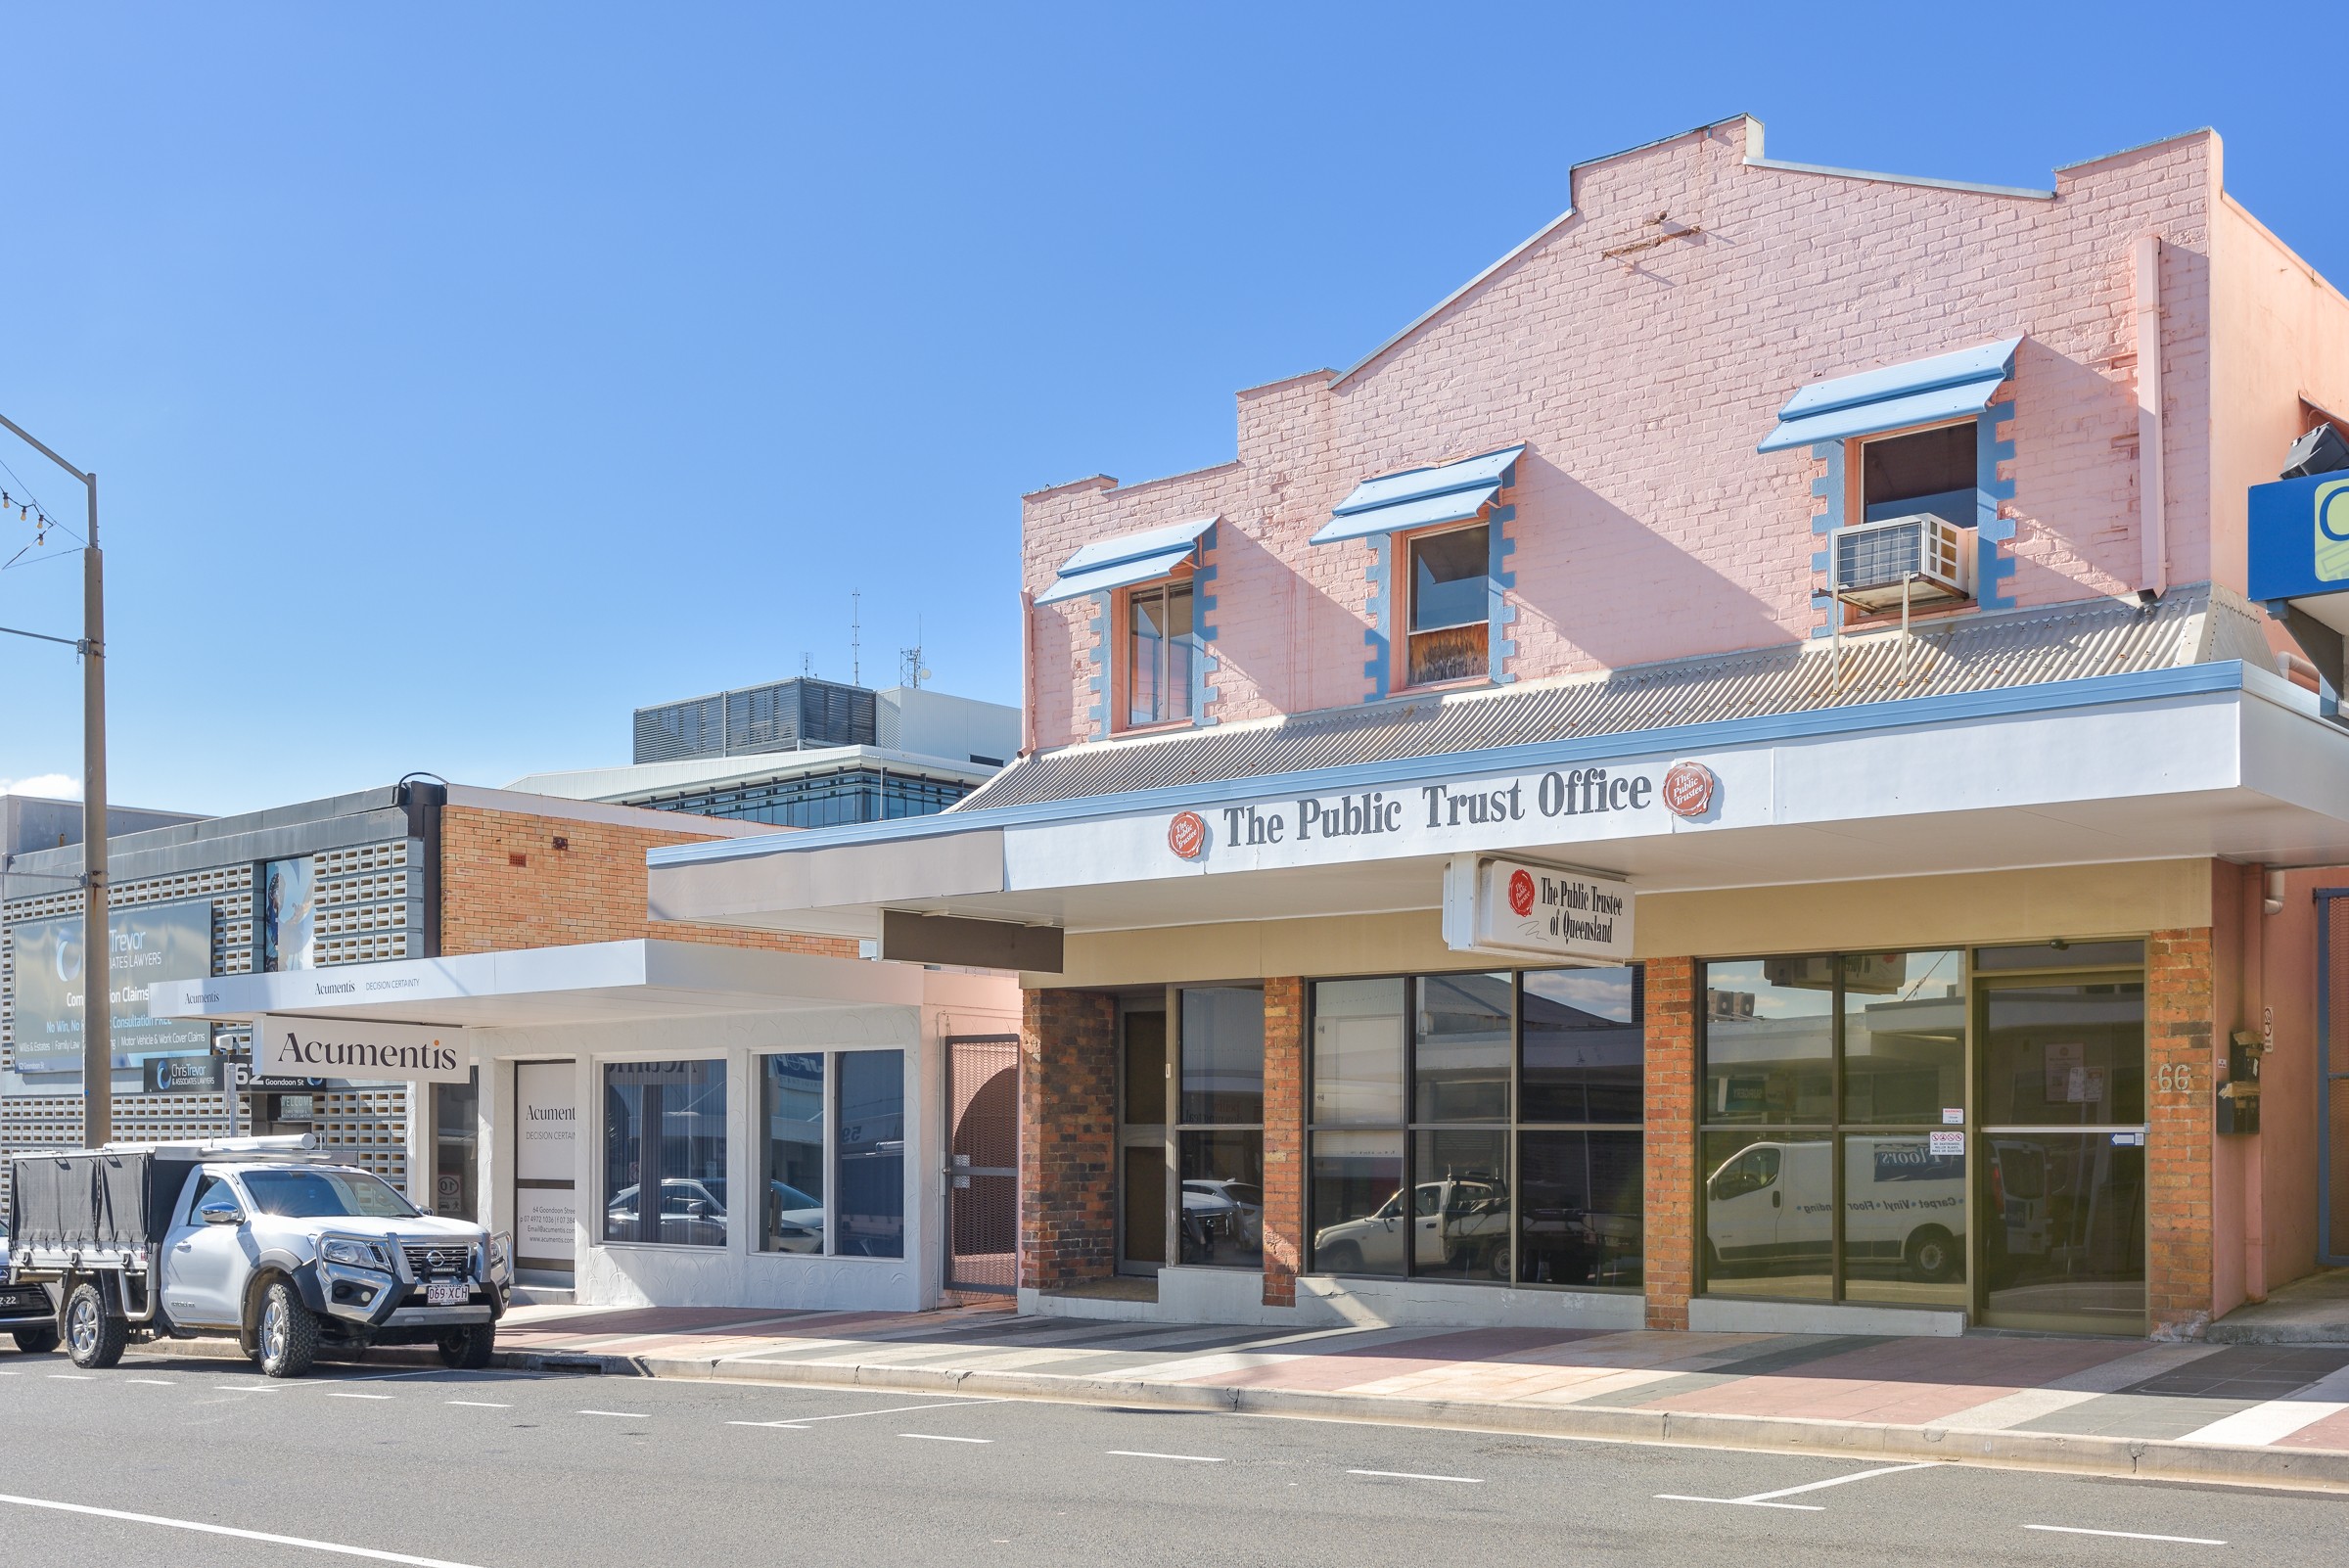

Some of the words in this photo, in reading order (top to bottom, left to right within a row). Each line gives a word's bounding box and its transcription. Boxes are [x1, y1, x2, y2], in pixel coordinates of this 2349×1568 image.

[1674, 777, 1699, 799] Public
[1675, 772, 1691, 787] The
[1674, 784, 1704, 807] Trustee
[1222, 806, 1284, 847] The
[1297, 791, 1402, 841] Public
[1422, 778, 1525, 829] Trust
[1538, 767, 1652, 818] Office
[1175, 820, 1187, 833] The
[1542, 876, 1558, 906] The
[1560, 880, 1589, 912] Public
[1590, 885, 1623, 916] Trustee
[1549, 908, 1560, 936] of
[1563, 909, 1613, 945] Queensland
[129, 951, 162, 968] LAWYERS
[315, 979, 355, 995] Acumentis
[365, 981, 391, 992] DECISION
[391, 978, 420, 989] CERTAINTY
[122, 986, 149, 1002] Claims
[185, 990, 220, 1004] Acumentis
[46, 1021, 56, 1034] No
[70, 1019, 80, 1032] No
[113, 1014, 154, 1029] Consultation
[55, 1039, 69, 1053] Family
[69, 1039, 80, 1050] Law
[121, 1037, 137, 1047] Motor
[137, 1035, 154, 1045] Vehicle
[159, 1034, 172, 1044] Work
[172, 1033, 187, 1043] Cover
[187, 1032, 206, 1042] Claims
[278, 1032, 457, 1071] Acumentis
[265, 1078, 297, 1086] Goondoon
[2157, 1063, 2191, 1091] 66
[526, 1104, 576, 1121] Acument
[526, 1130, 553, 1140] DECISION
